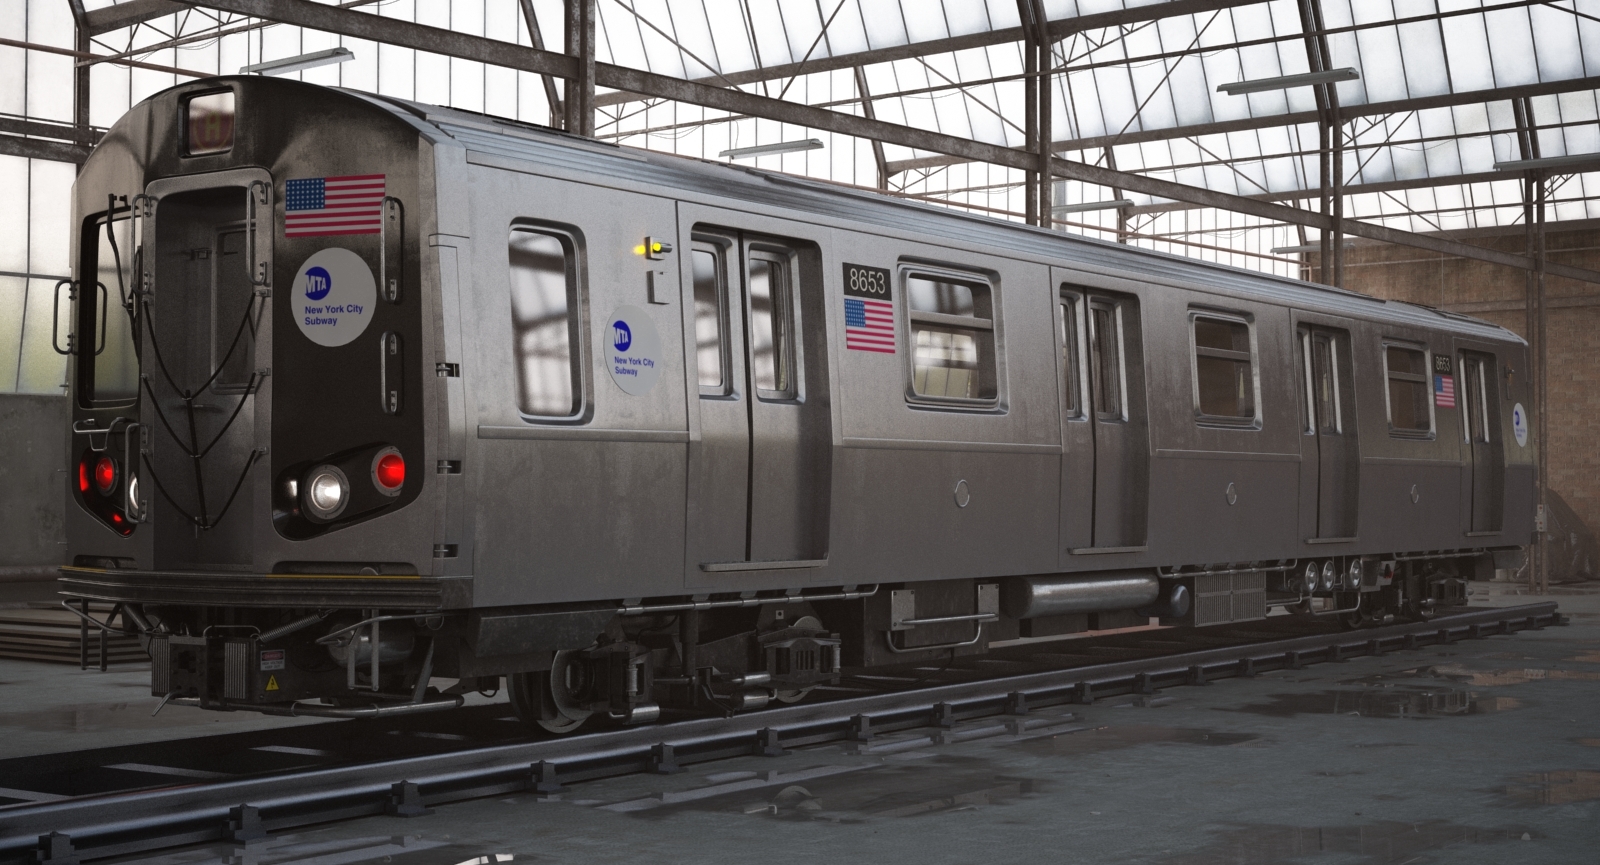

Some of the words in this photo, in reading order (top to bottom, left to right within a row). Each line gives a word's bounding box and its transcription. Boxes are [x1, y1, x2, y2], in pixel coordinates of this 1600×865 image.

[305, 273, 328, 295] MTA
[850, 267, 886, 294] 8653
[305, 306, 323, 314] New
[325, 304, 344, 313] York
[346, 304, 363, 315] City
[305, 316, 338, 327] Subway
[613, 325, 630, 346] MTA
[614, 356, 628, 365] New
[628, 356, 642, 366] York
[643, 358, 655, 368] City
[615, 366, 638, 377] Subway
